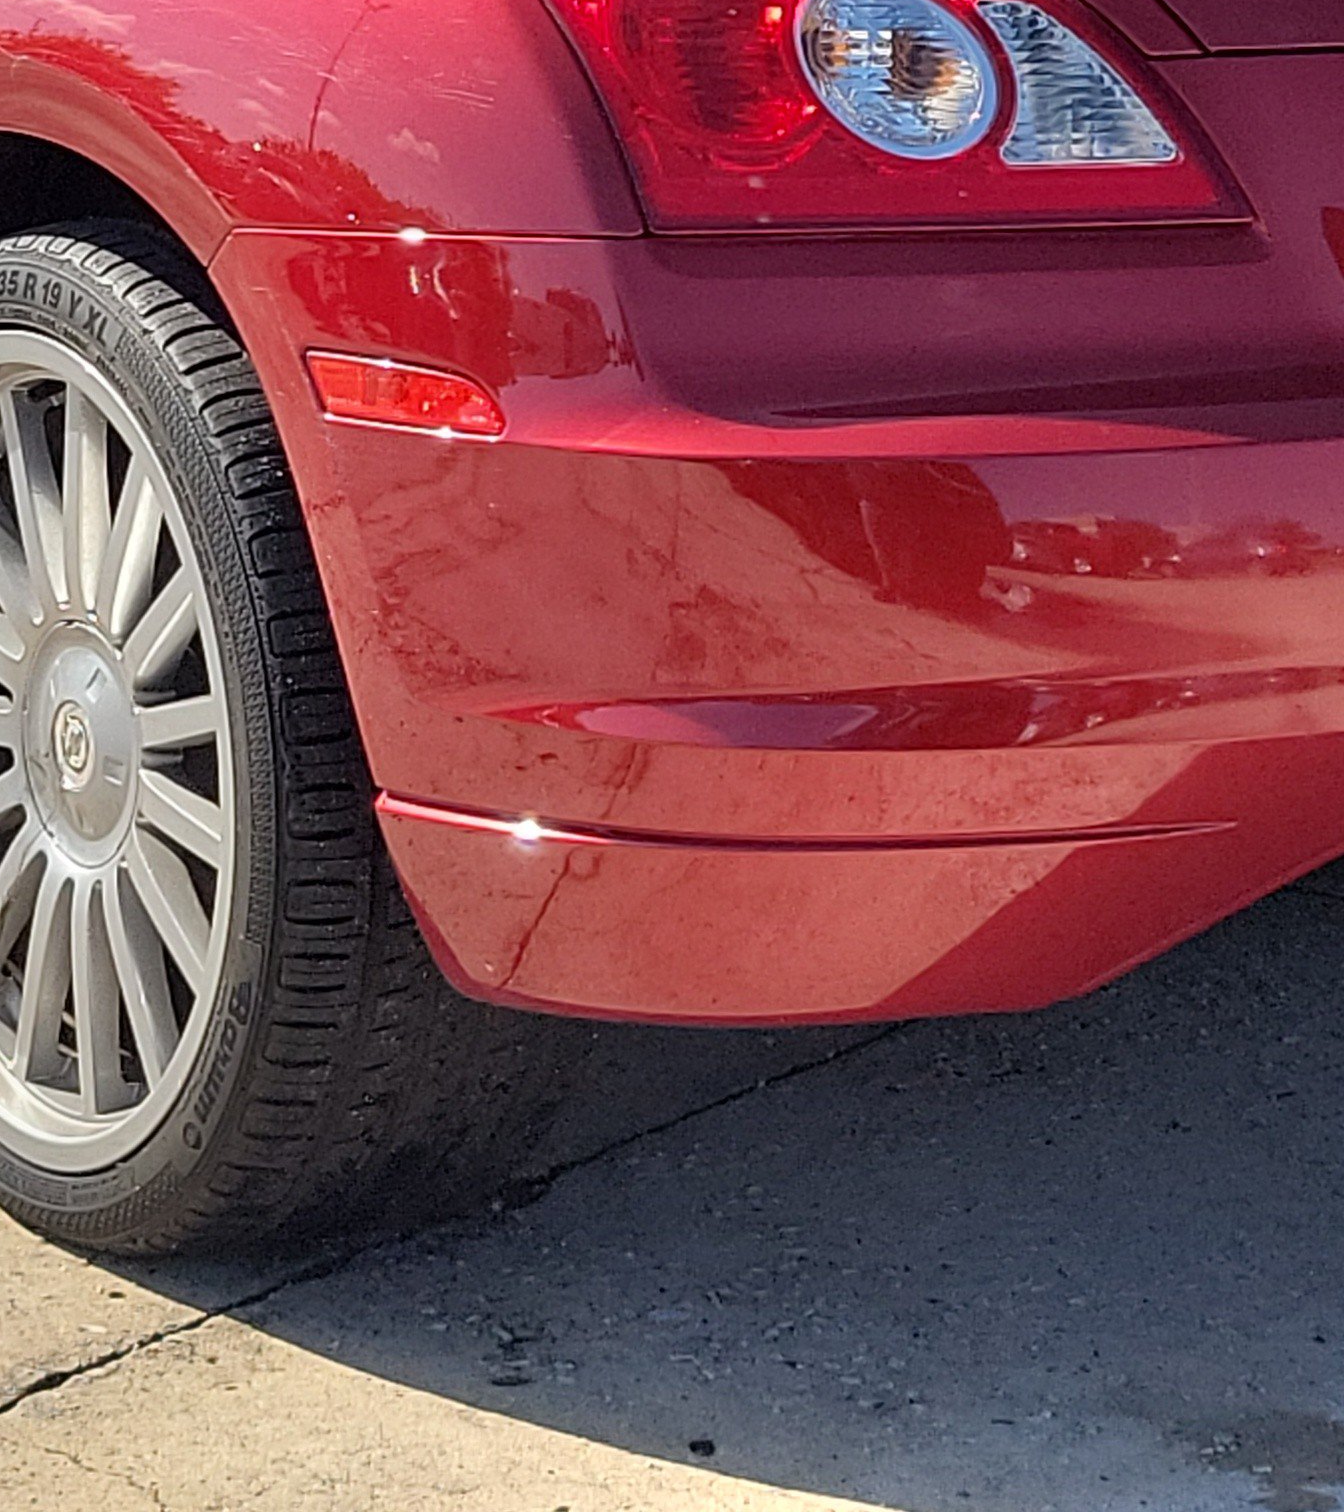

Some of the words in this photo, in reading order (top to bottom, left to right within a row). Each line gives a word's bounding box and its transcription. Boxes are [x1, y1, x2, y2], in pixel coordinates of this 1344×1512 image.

[23, 272, 38, 300] R
[43, 278, 62, 309] 19
[68, 290, 83, 319] Y
[82, 305, 109, 346] XL
